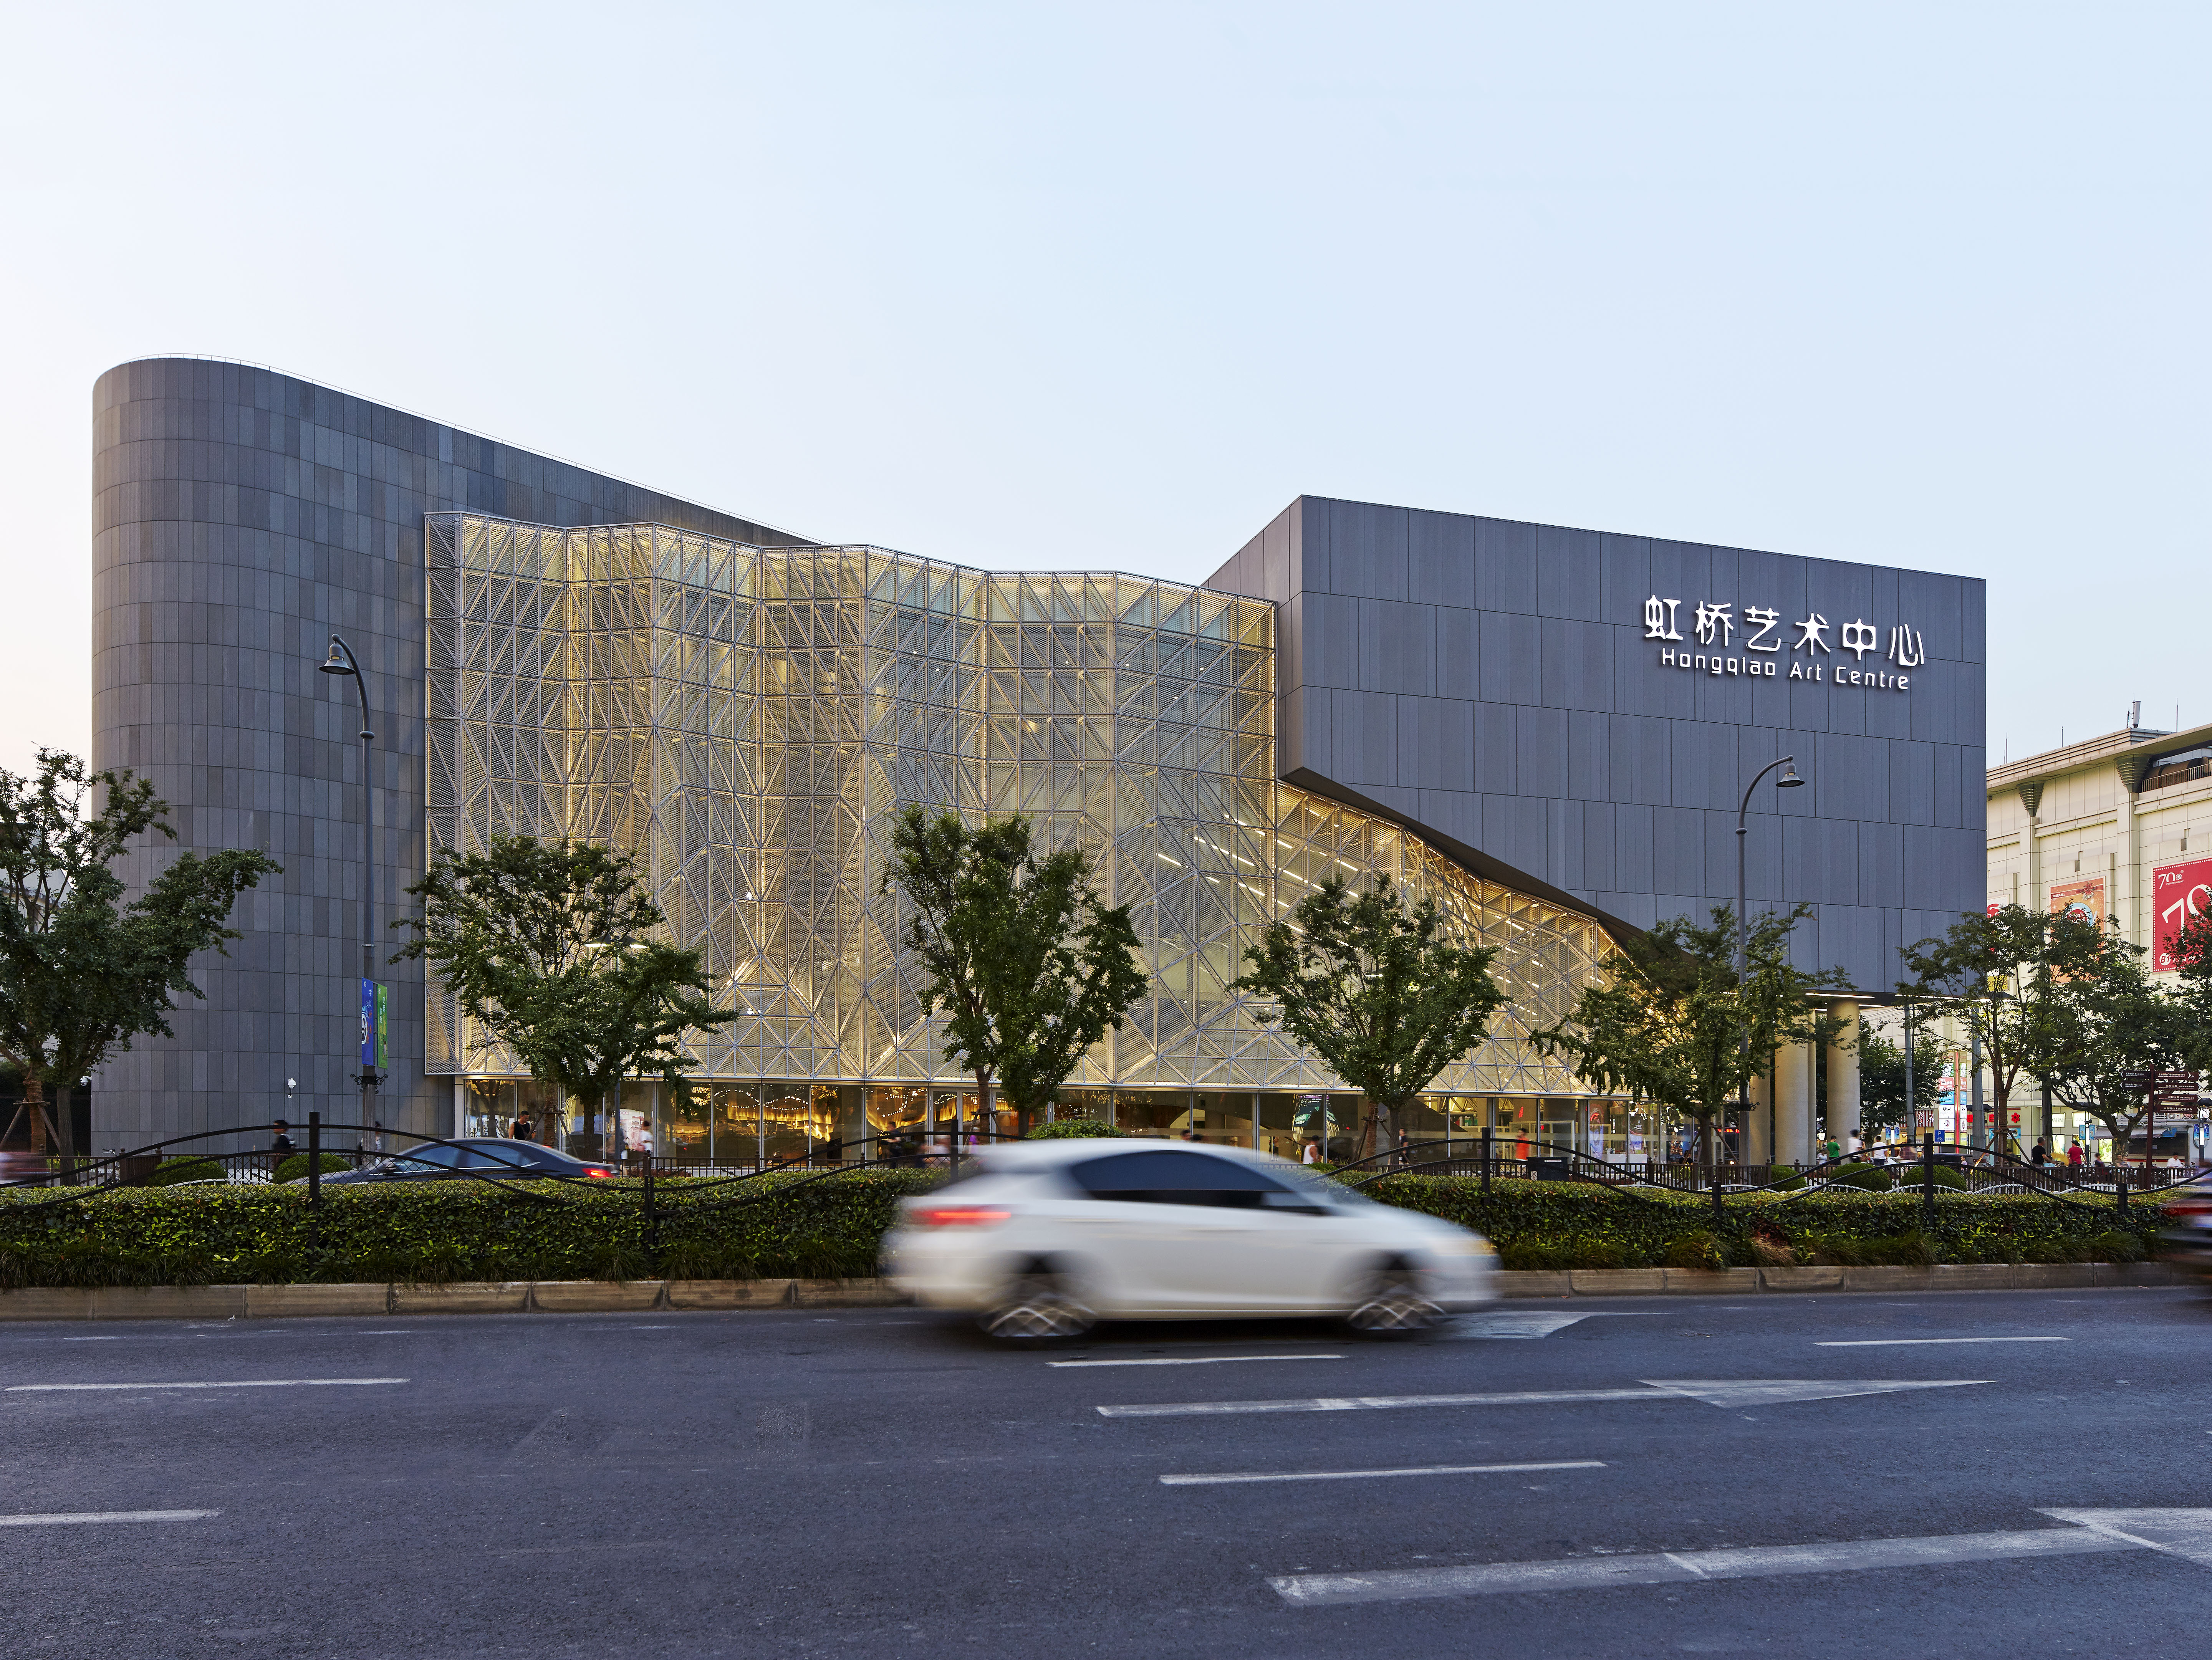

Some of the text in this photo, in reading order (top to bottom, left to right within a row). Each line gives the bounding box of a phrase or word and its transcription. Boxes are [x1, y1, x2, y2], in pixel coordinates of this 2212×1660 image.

[1645, 594, 1925, 667] 虹桥艺术中心
[1662, 647, 1909, 690] Hongqiao Art Centre
